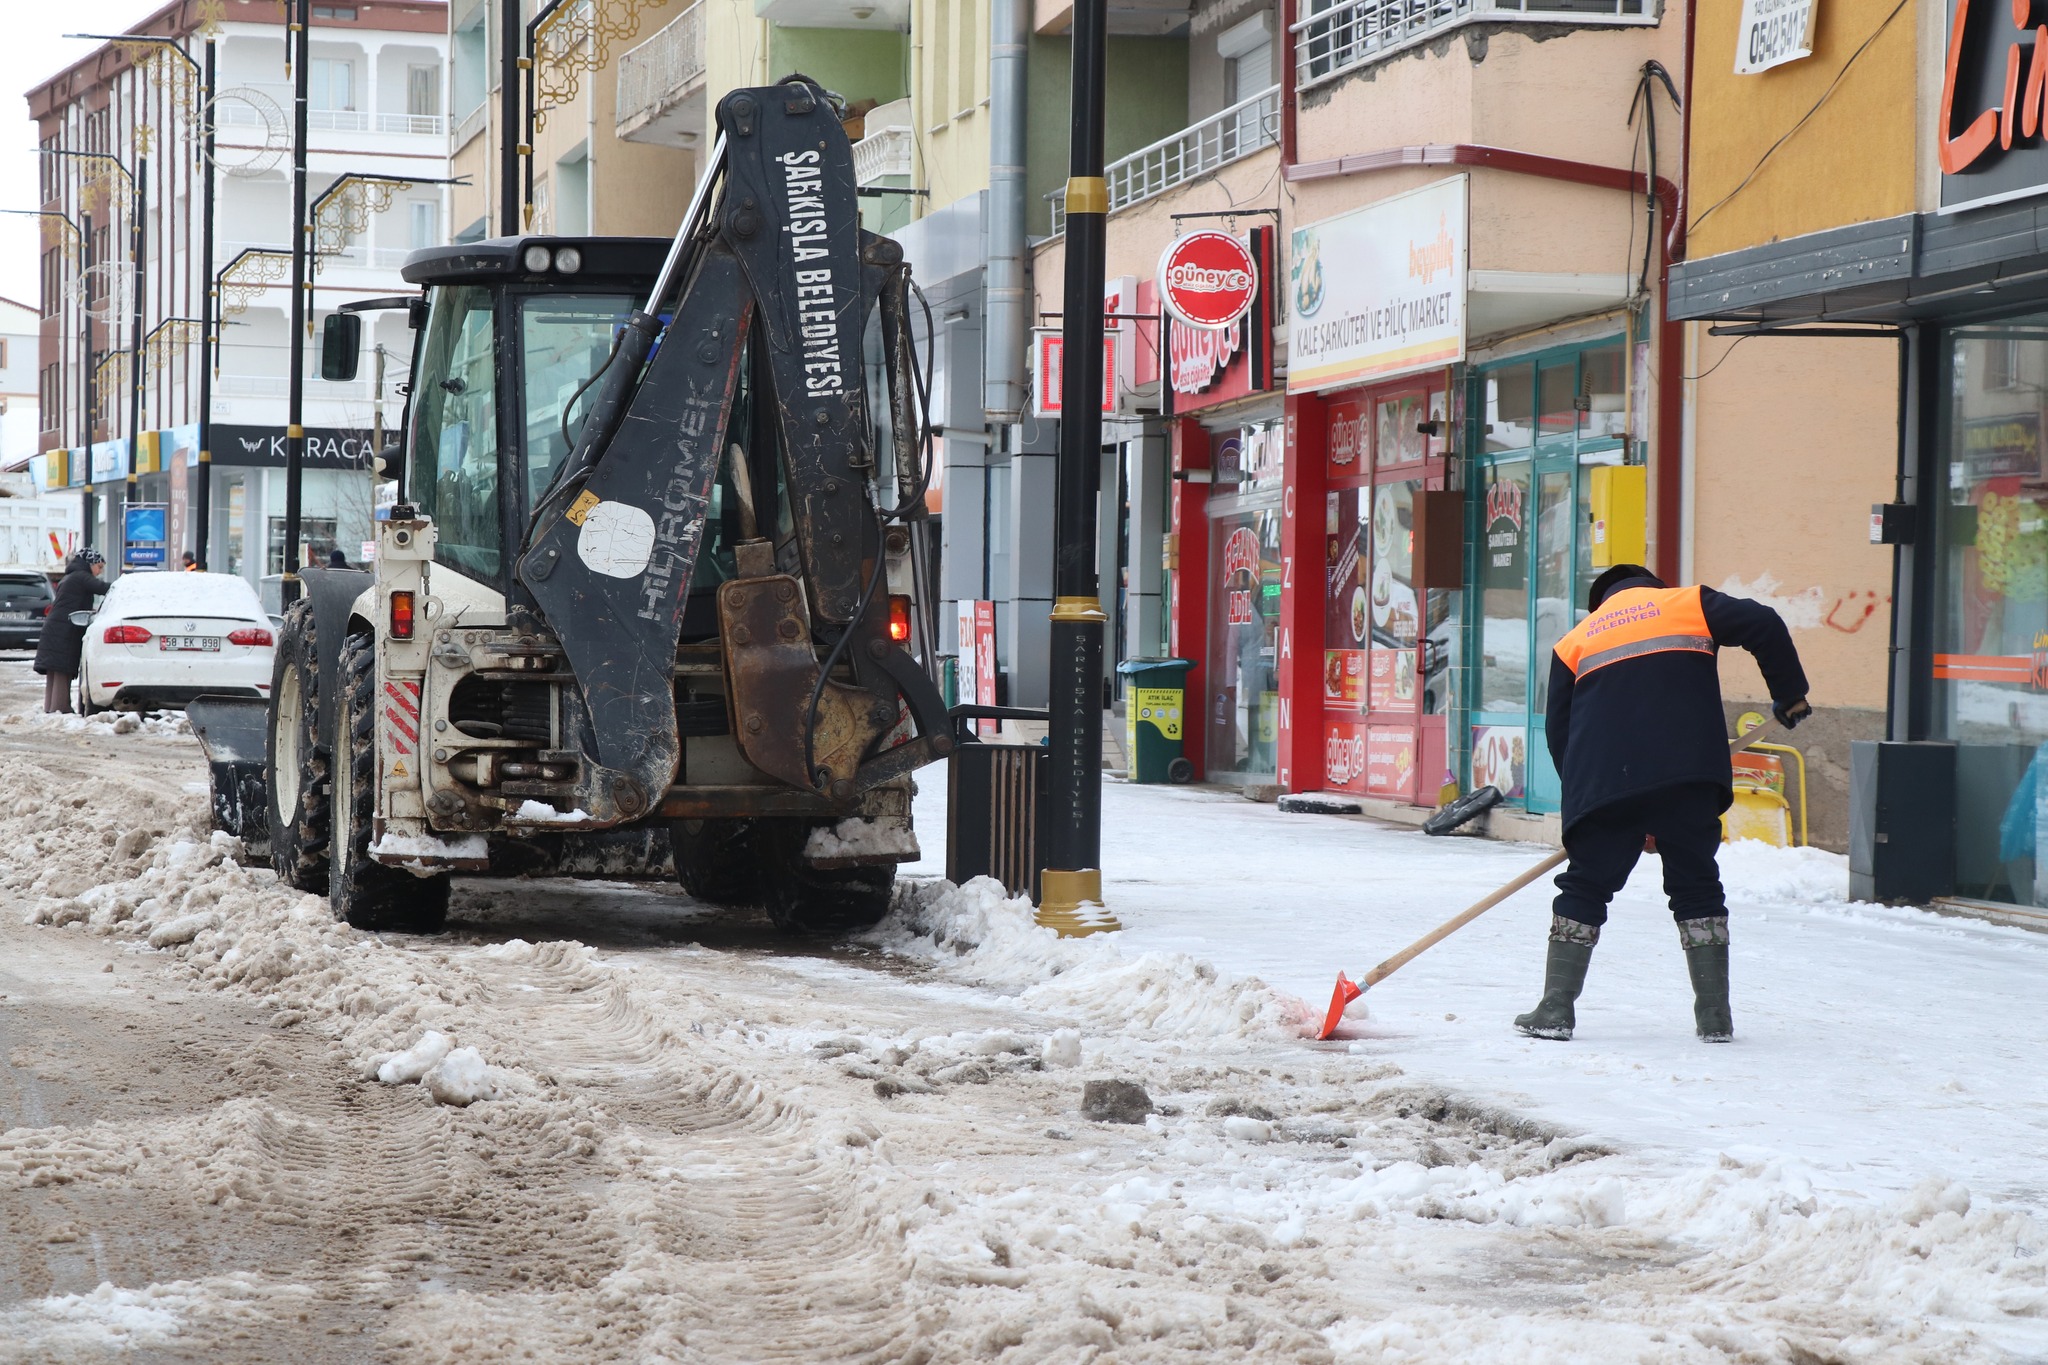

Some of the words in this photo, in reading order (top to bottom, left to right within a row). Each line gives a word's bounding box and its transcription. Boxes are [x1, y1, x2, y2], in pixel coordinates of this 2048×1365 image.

[1749, 17, 1779, 65] 0542
[1780, 10, 1799, 57] 541
[776, 150, 830, 263] ŞARKIŞLA
[796, 268, 844, 398] BELEDİYESİ
[1297, 325, 1318, 358] KALE
[1320, 306, 1369, 362] ŞARKÜTERİ
[1370, 309, 1382, 341] VE
[1384, 297, 1407, 343] PİLİÇ
[1409, 292, 1452, 333] MARKET
[271, 435, 374, 460] KRACA
[1486, 479, 1521, 532] KALE
[1586, 609, 1661, 638] BELEDİYESİ
[1589, 601, 1655, 629] ŞARKIŞLA
[167, 637, 177, 647] 58
[184, 637, 195, 647] EK
[202, 638, 219, 648] 898
